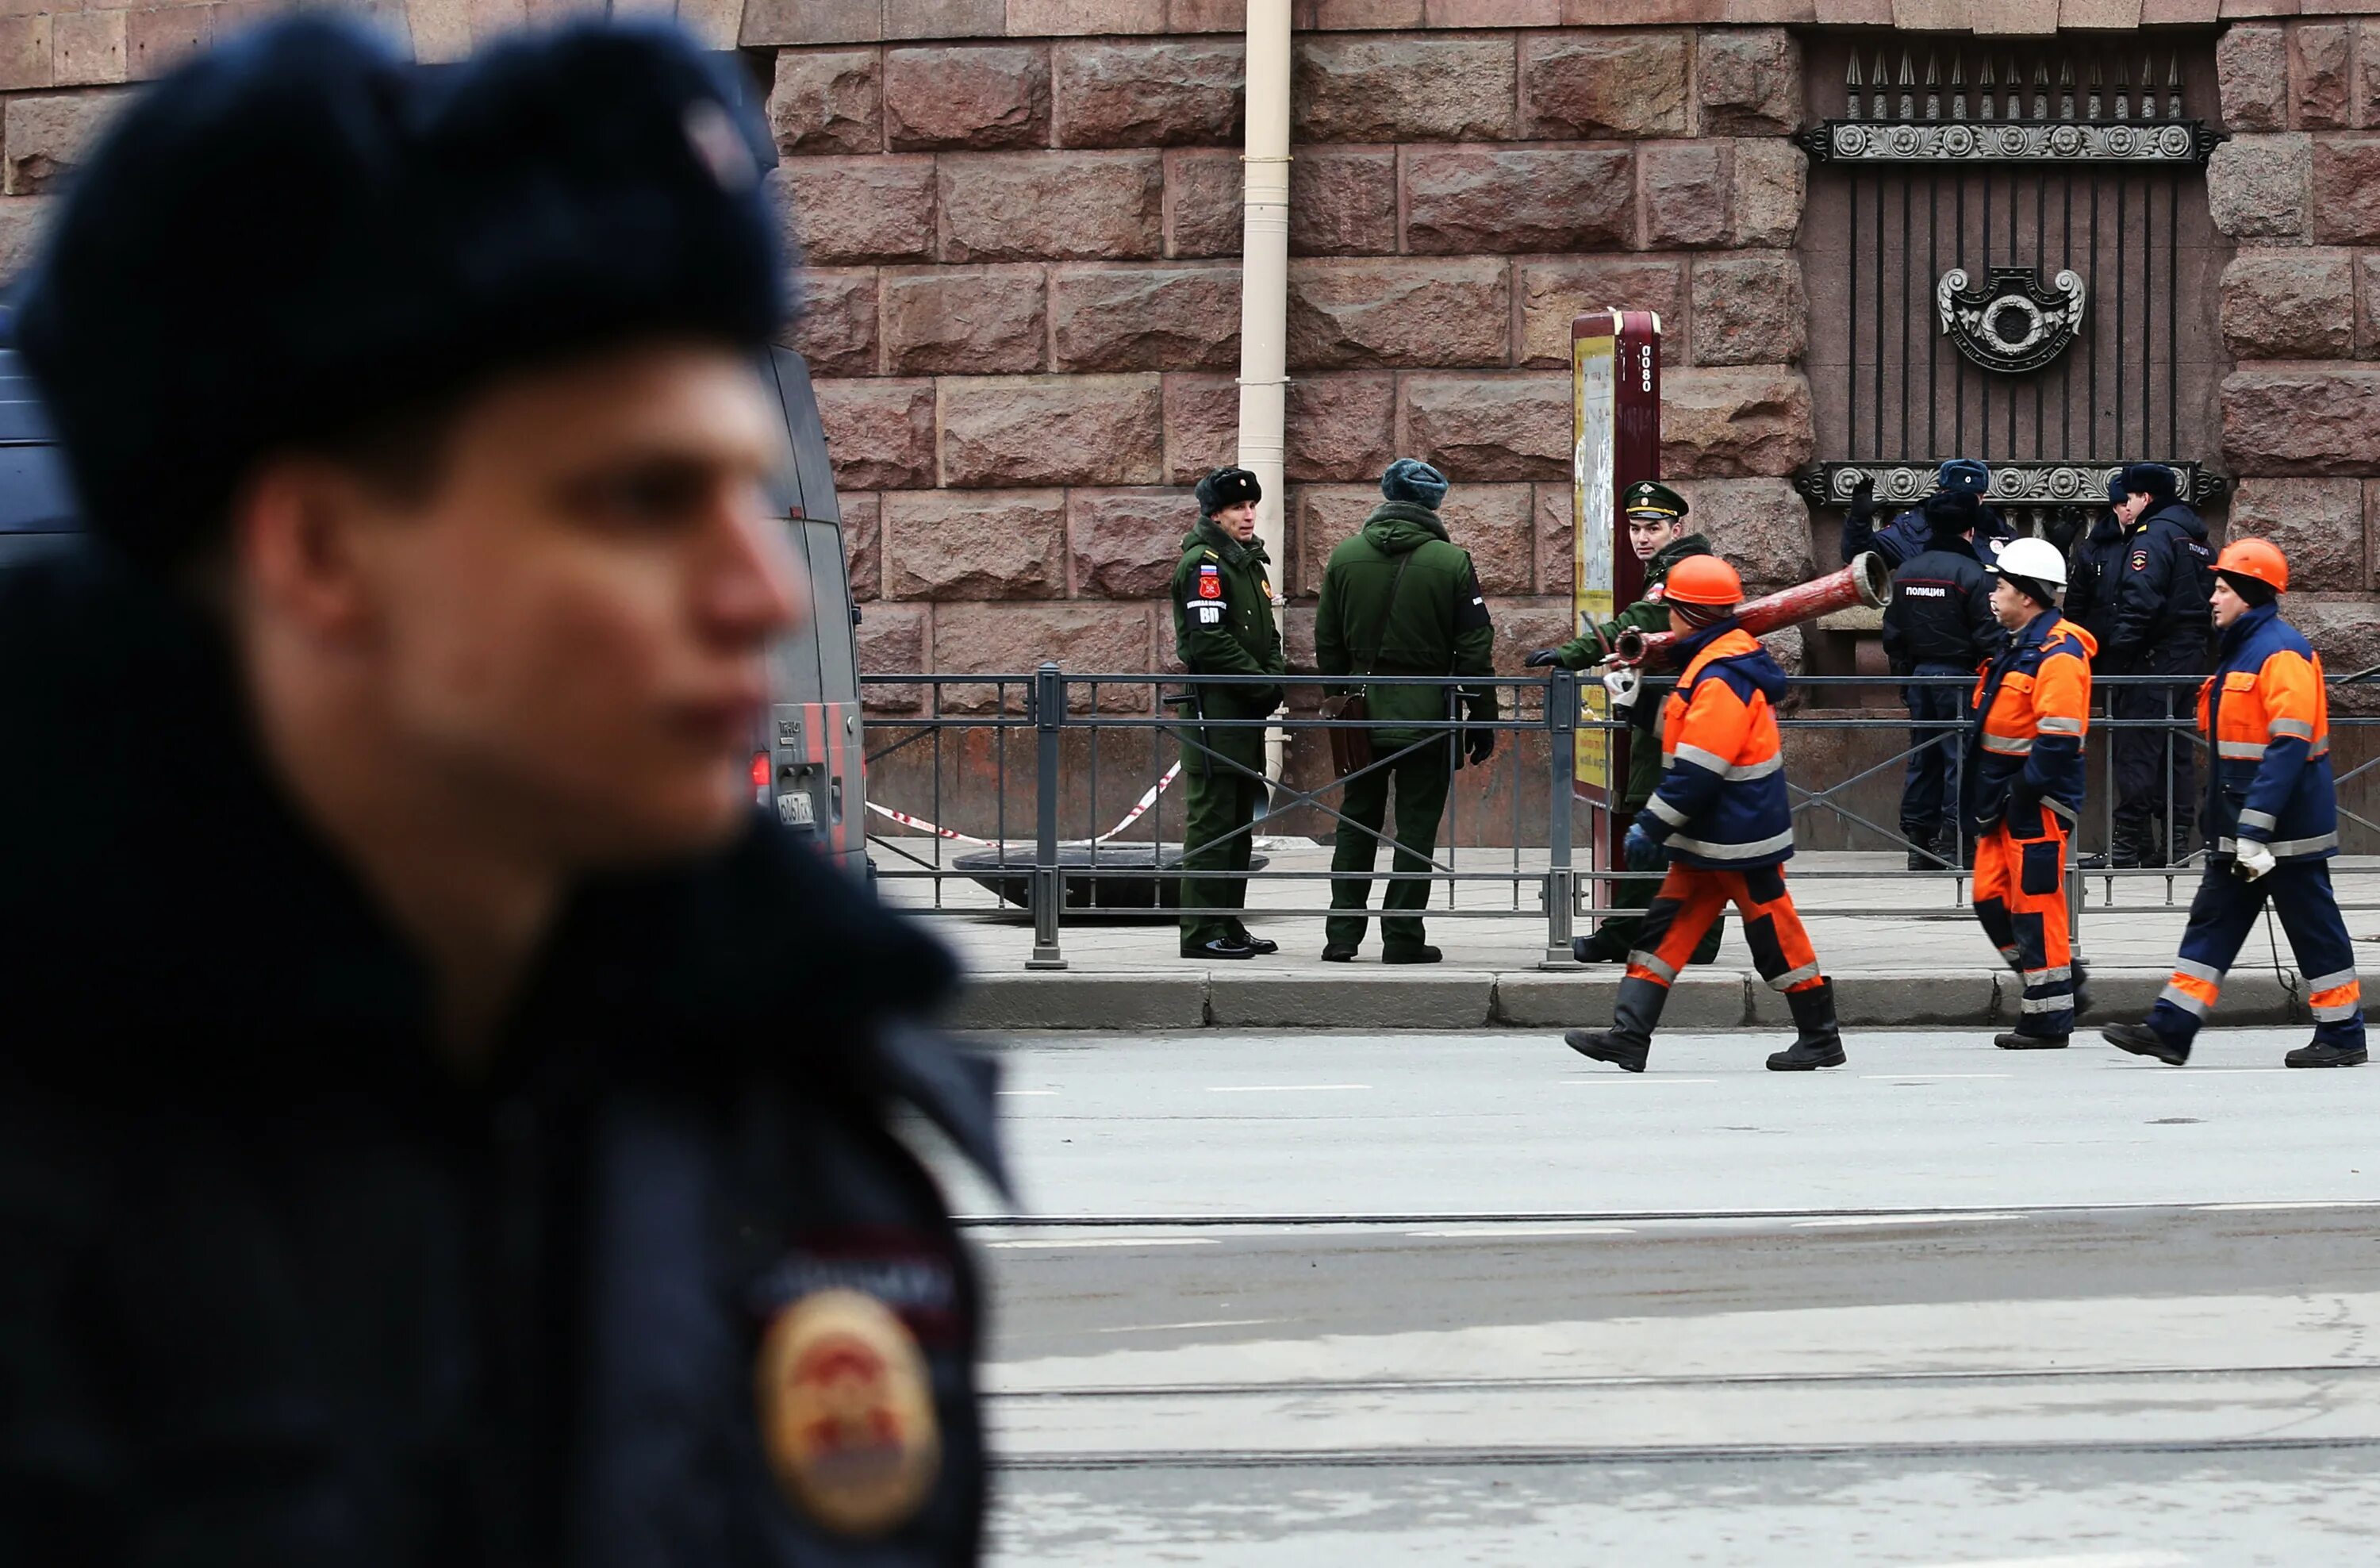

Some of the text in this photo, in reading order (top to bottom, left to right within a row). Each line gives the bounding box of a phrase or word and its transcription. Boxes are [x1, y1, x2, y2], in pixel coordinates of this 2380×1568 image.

[1641, 345, 1651, 392] 0080
[1906, 586, 1946, 598] ПОЛИЦИЯ
[1200, 607, 1219, 623] ВП
